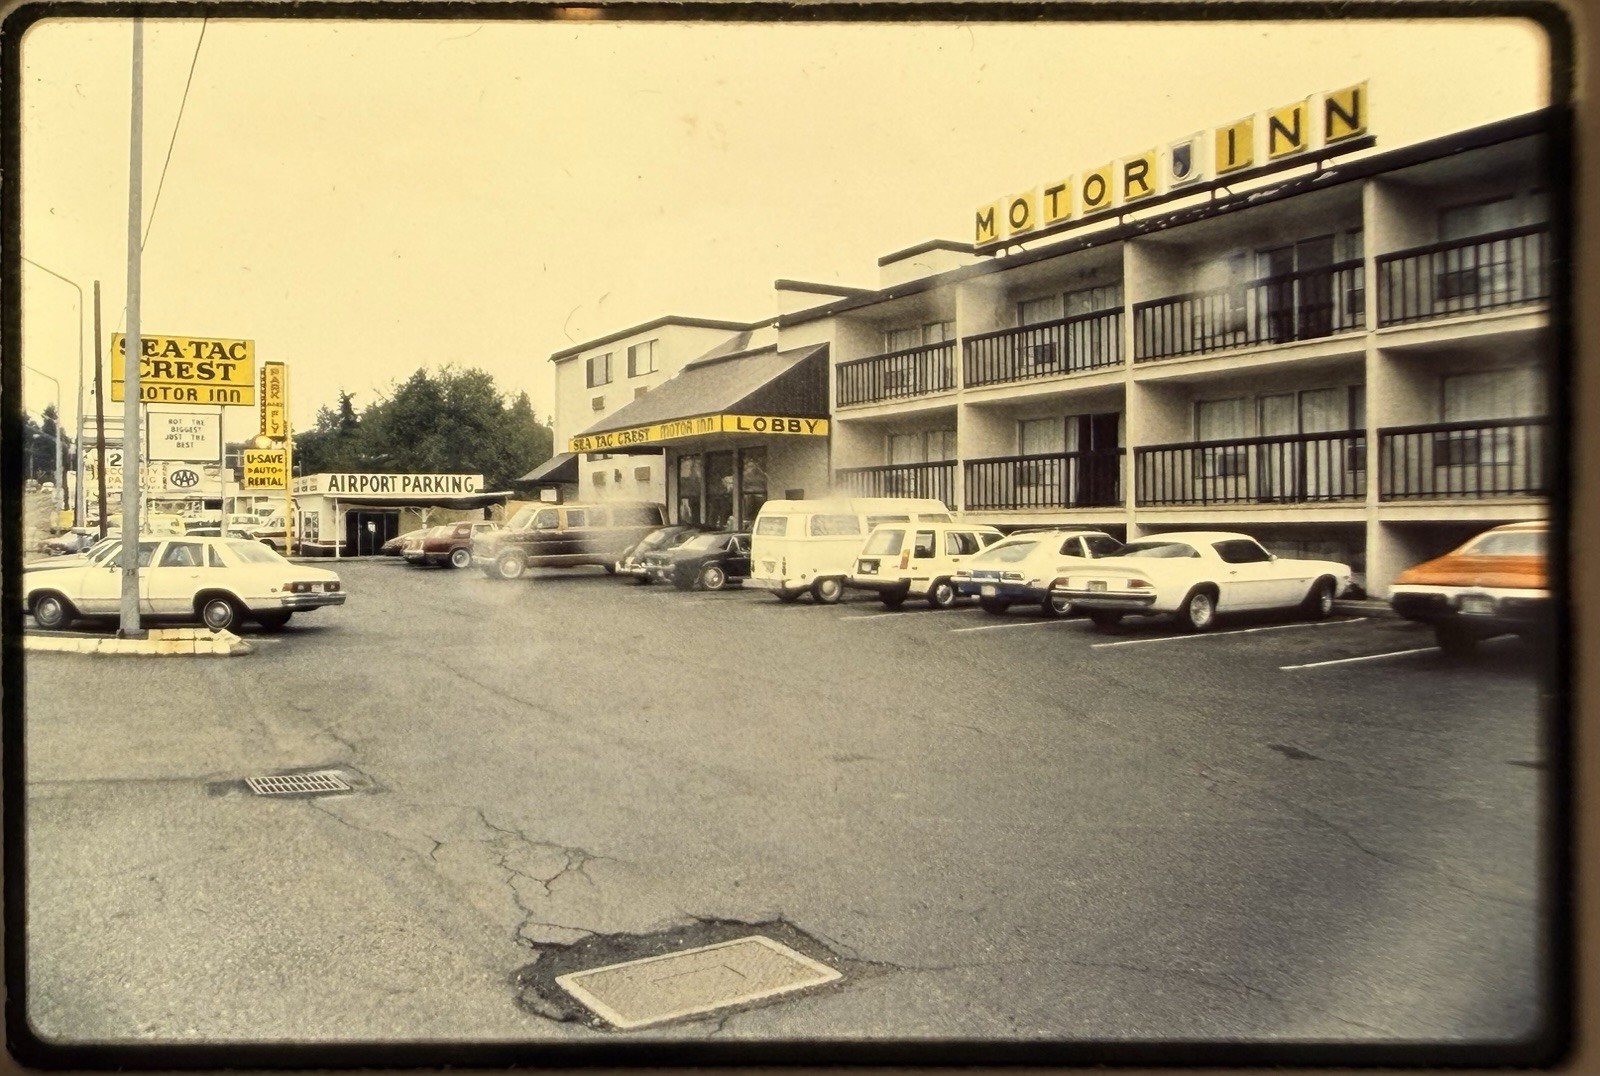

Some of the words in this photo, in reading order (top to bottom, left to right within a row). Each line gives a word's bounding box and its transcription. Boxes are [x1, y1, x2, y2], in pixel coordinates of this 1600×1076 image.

[976, 159, 1150, 241] MOTOR
[1228, 89, 1360, 165] INN
[736, 417, 819, 434] LOBBY
[573, 438, 592, 451] SEA
[596, 434, 614, 448] TAC
[618, 428, 650, 445] CREST
[660, 419, 693, 437] MOTOR
[246, 454, 284, 464] U-SAVE
[171, 470, 199, 487] AAA
[253, 466, 278, 475] AUTO
[247, 477, 284, 487] RENTAL
[328, 474, 397, 493] AIRPORT
[402, 475, 475, 493] PARKING
